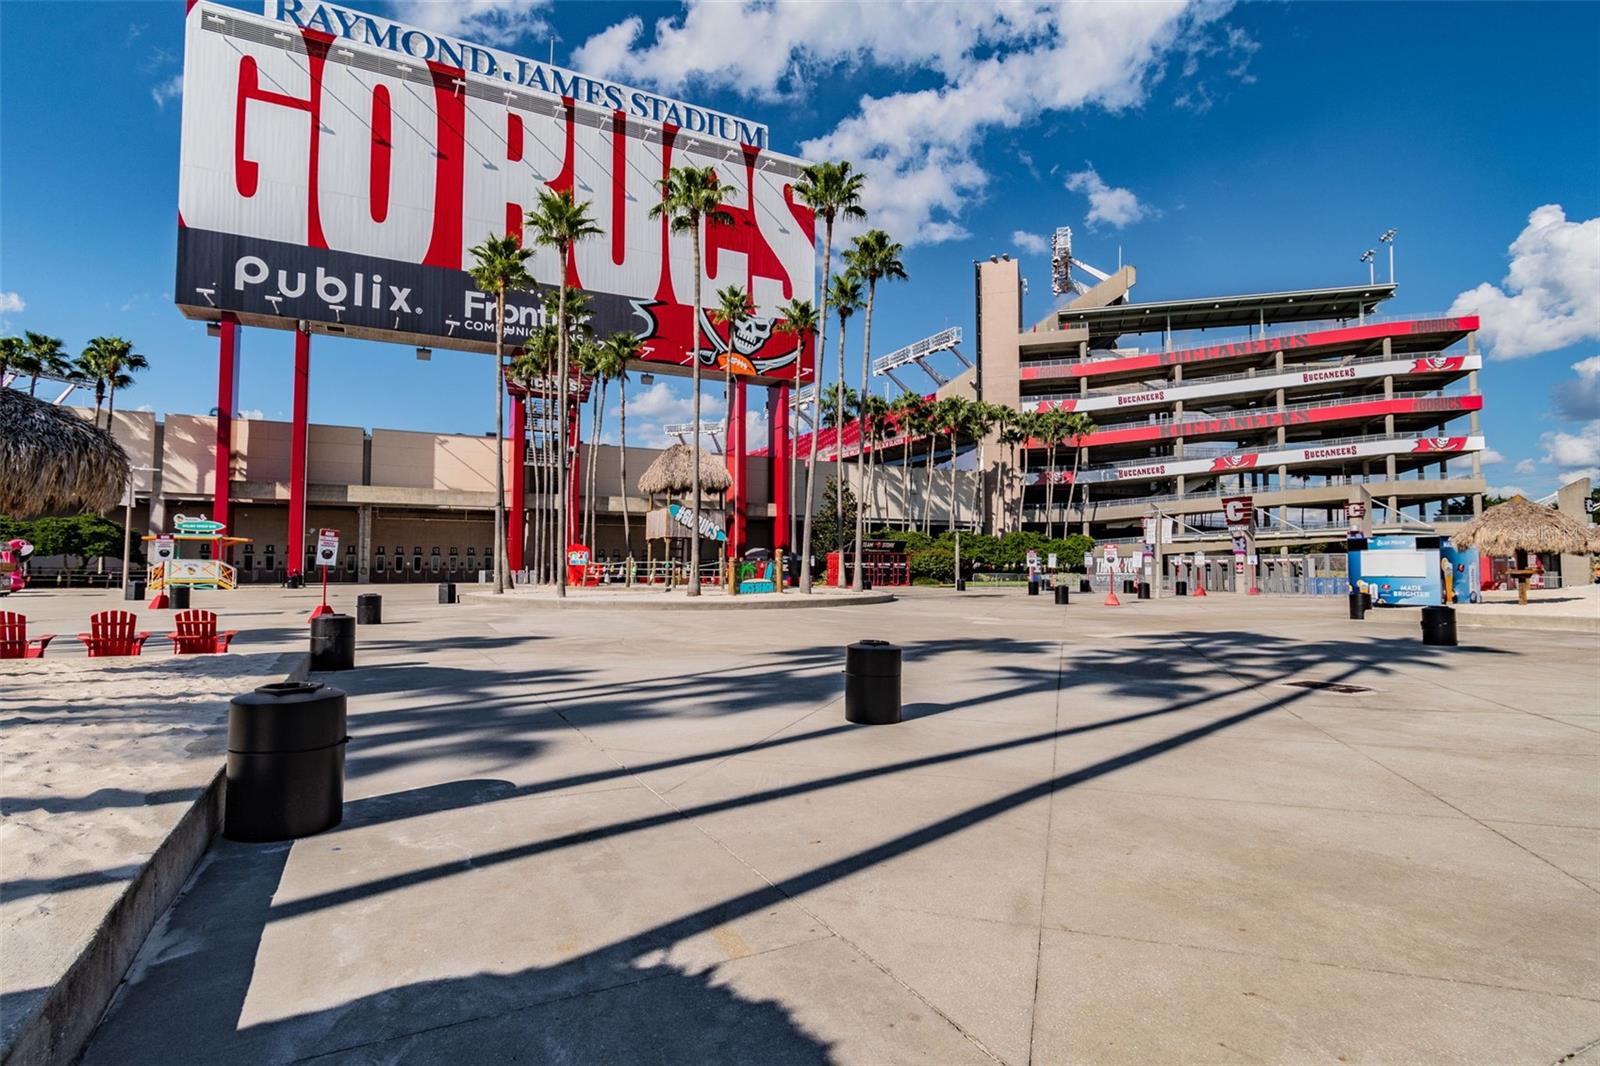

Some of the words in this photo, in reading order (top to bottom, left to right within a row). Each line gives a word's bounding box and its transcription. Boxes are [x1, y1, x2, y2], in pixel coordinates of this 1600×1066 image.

[274, 0, 496, 77] RAYMOND
[503, 60, 622, 111] JAMES
[630, 92, 765, 148] STADIUM
[234, 255, 412, 314] Publix
[1302, 368, 1356, 383] BUCCANEERS
[1118, 391, 1165, 405] BUCCANEERS
[1304, 445, 1357, 460] BUCCANEERS
[1118, 465, 1165, 478] BUCCANEERS
[1226, 501, 1244, 521] C
